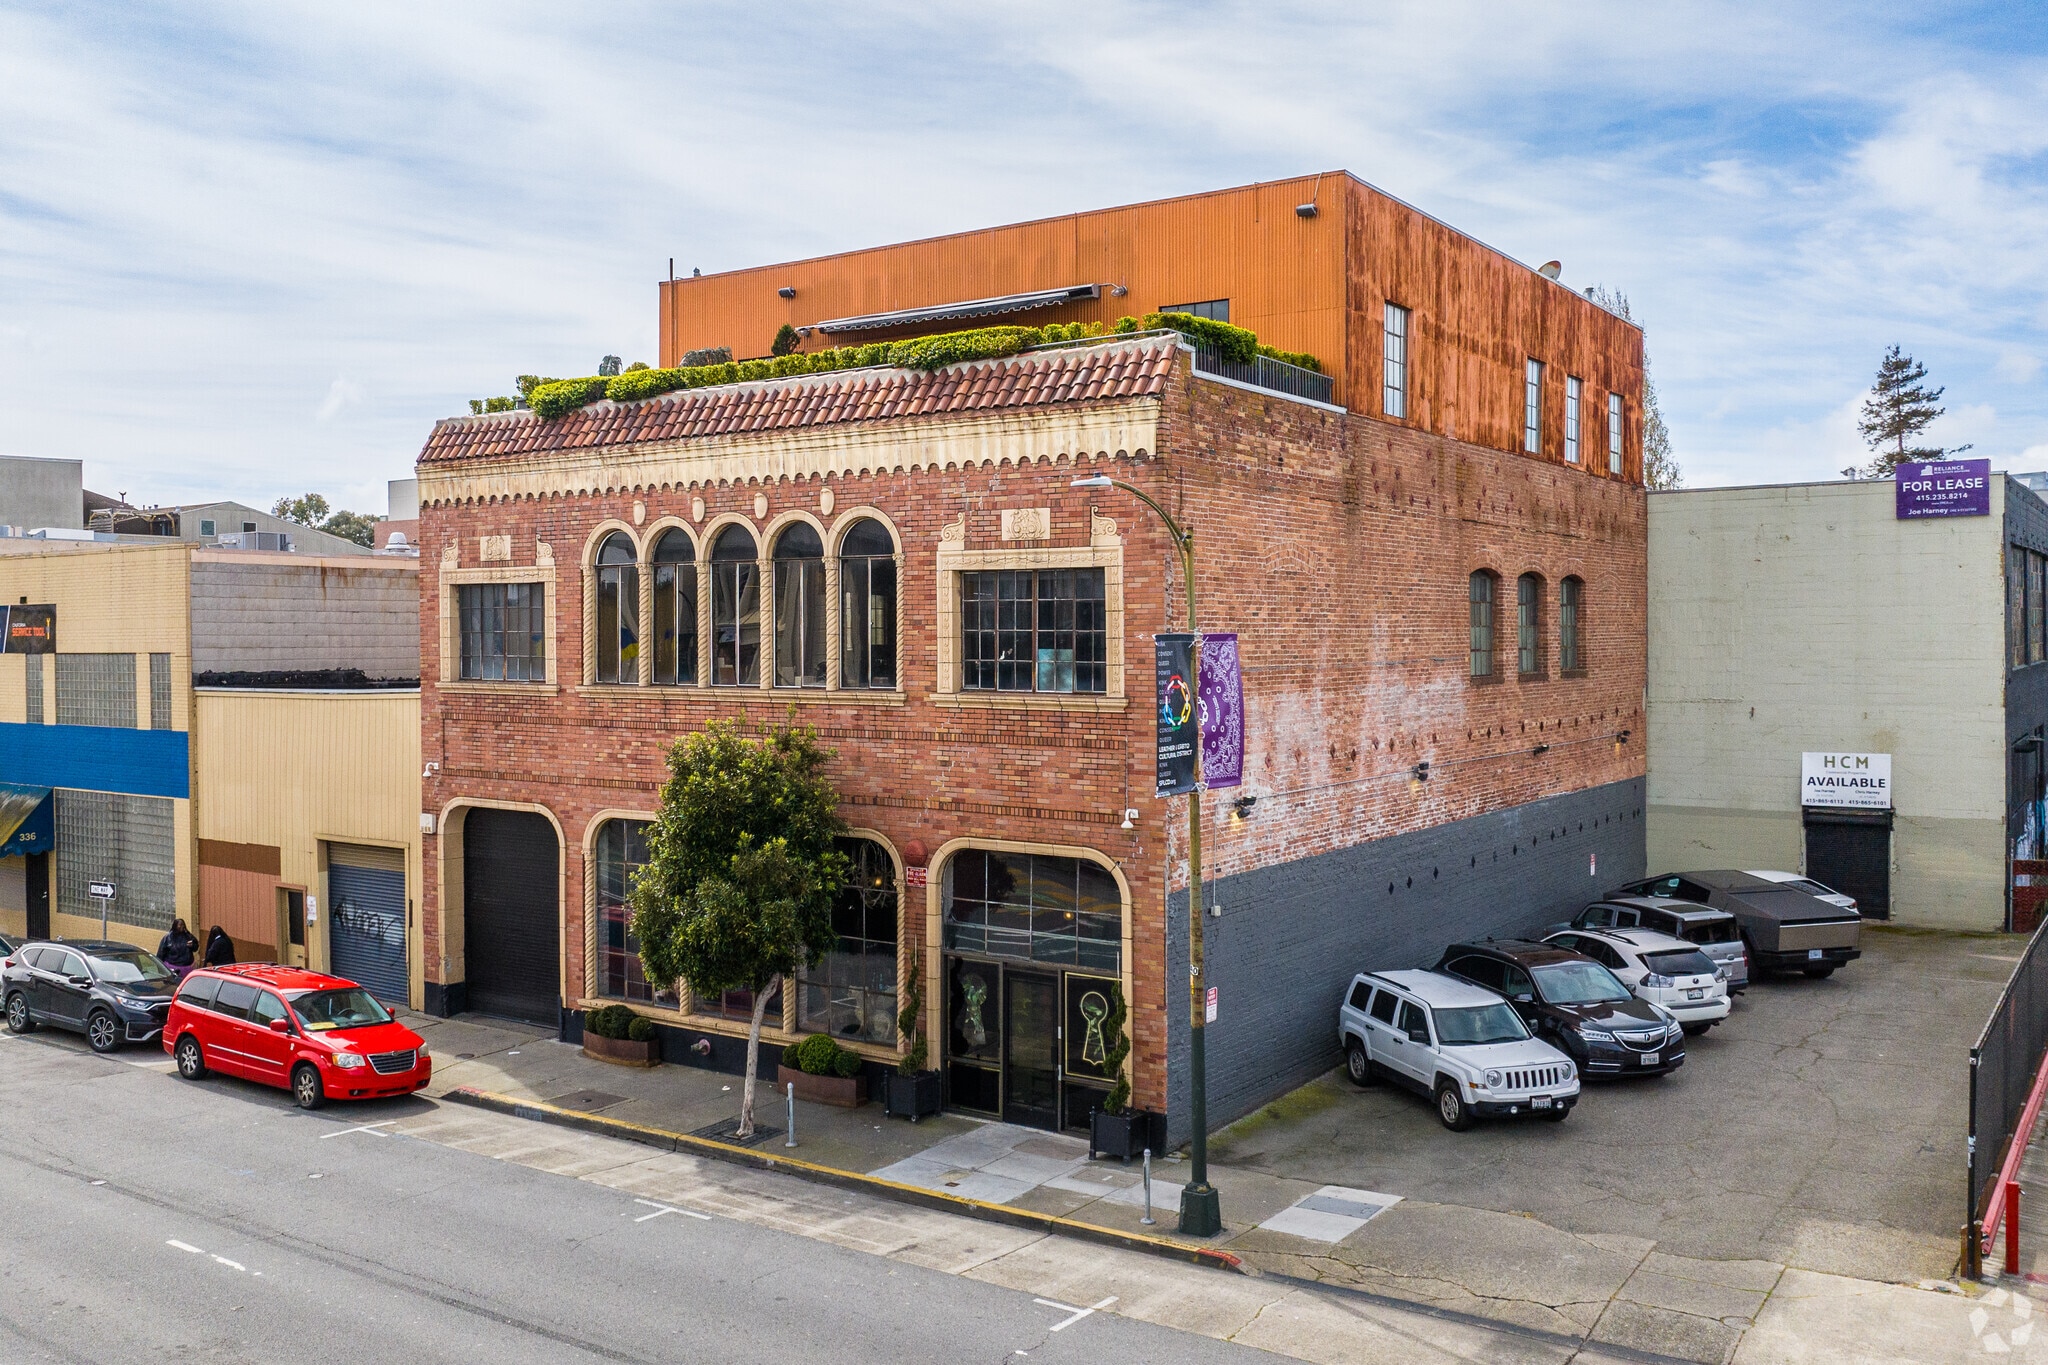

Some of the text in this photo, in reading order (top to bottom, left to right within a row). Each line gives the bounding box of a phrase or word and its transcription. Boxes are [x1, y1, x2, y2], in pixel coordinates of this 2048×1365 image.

[1903, 477, 1983, 492] FOR LEASE
[12, 627, 45, 637] SERVICE TOOL
[1824, 755, 1868, 768] HCM
[1807, 777, 1886, 788] AVAILABLE
[19, 832, 36, 841] 336
